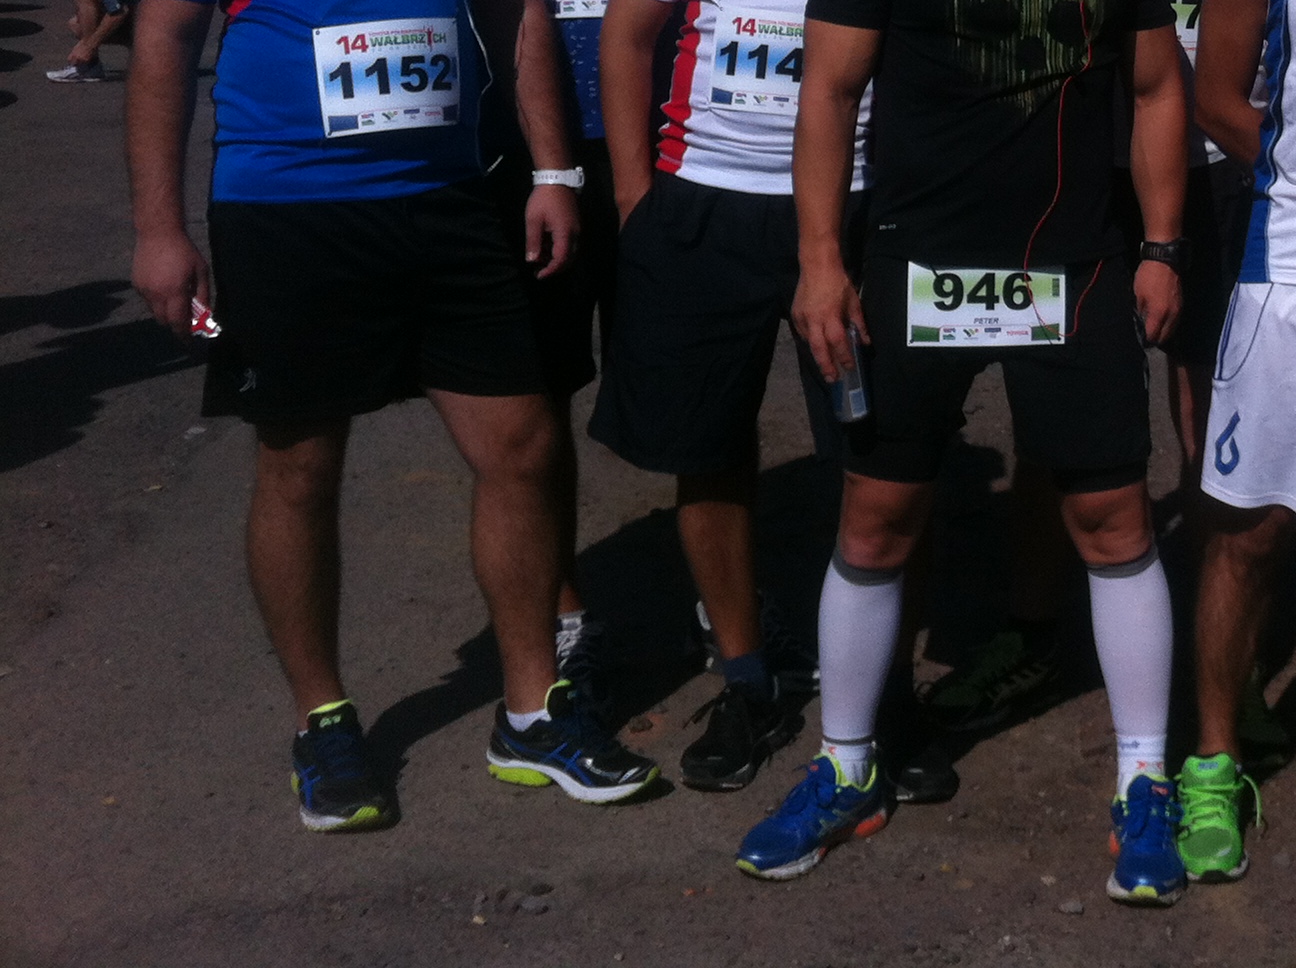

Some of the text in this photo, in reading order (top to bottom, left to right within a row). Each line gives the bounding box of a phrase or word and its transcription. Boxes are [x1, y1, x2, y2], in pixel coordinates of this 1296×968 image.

[732, 16, 757, 37] 14
[336, 33, 369, 55] 14
[328, 54, 453, 100] 1152
[932, 272, 1034, 312] 946
[973, 317, 999, 325] PETER
